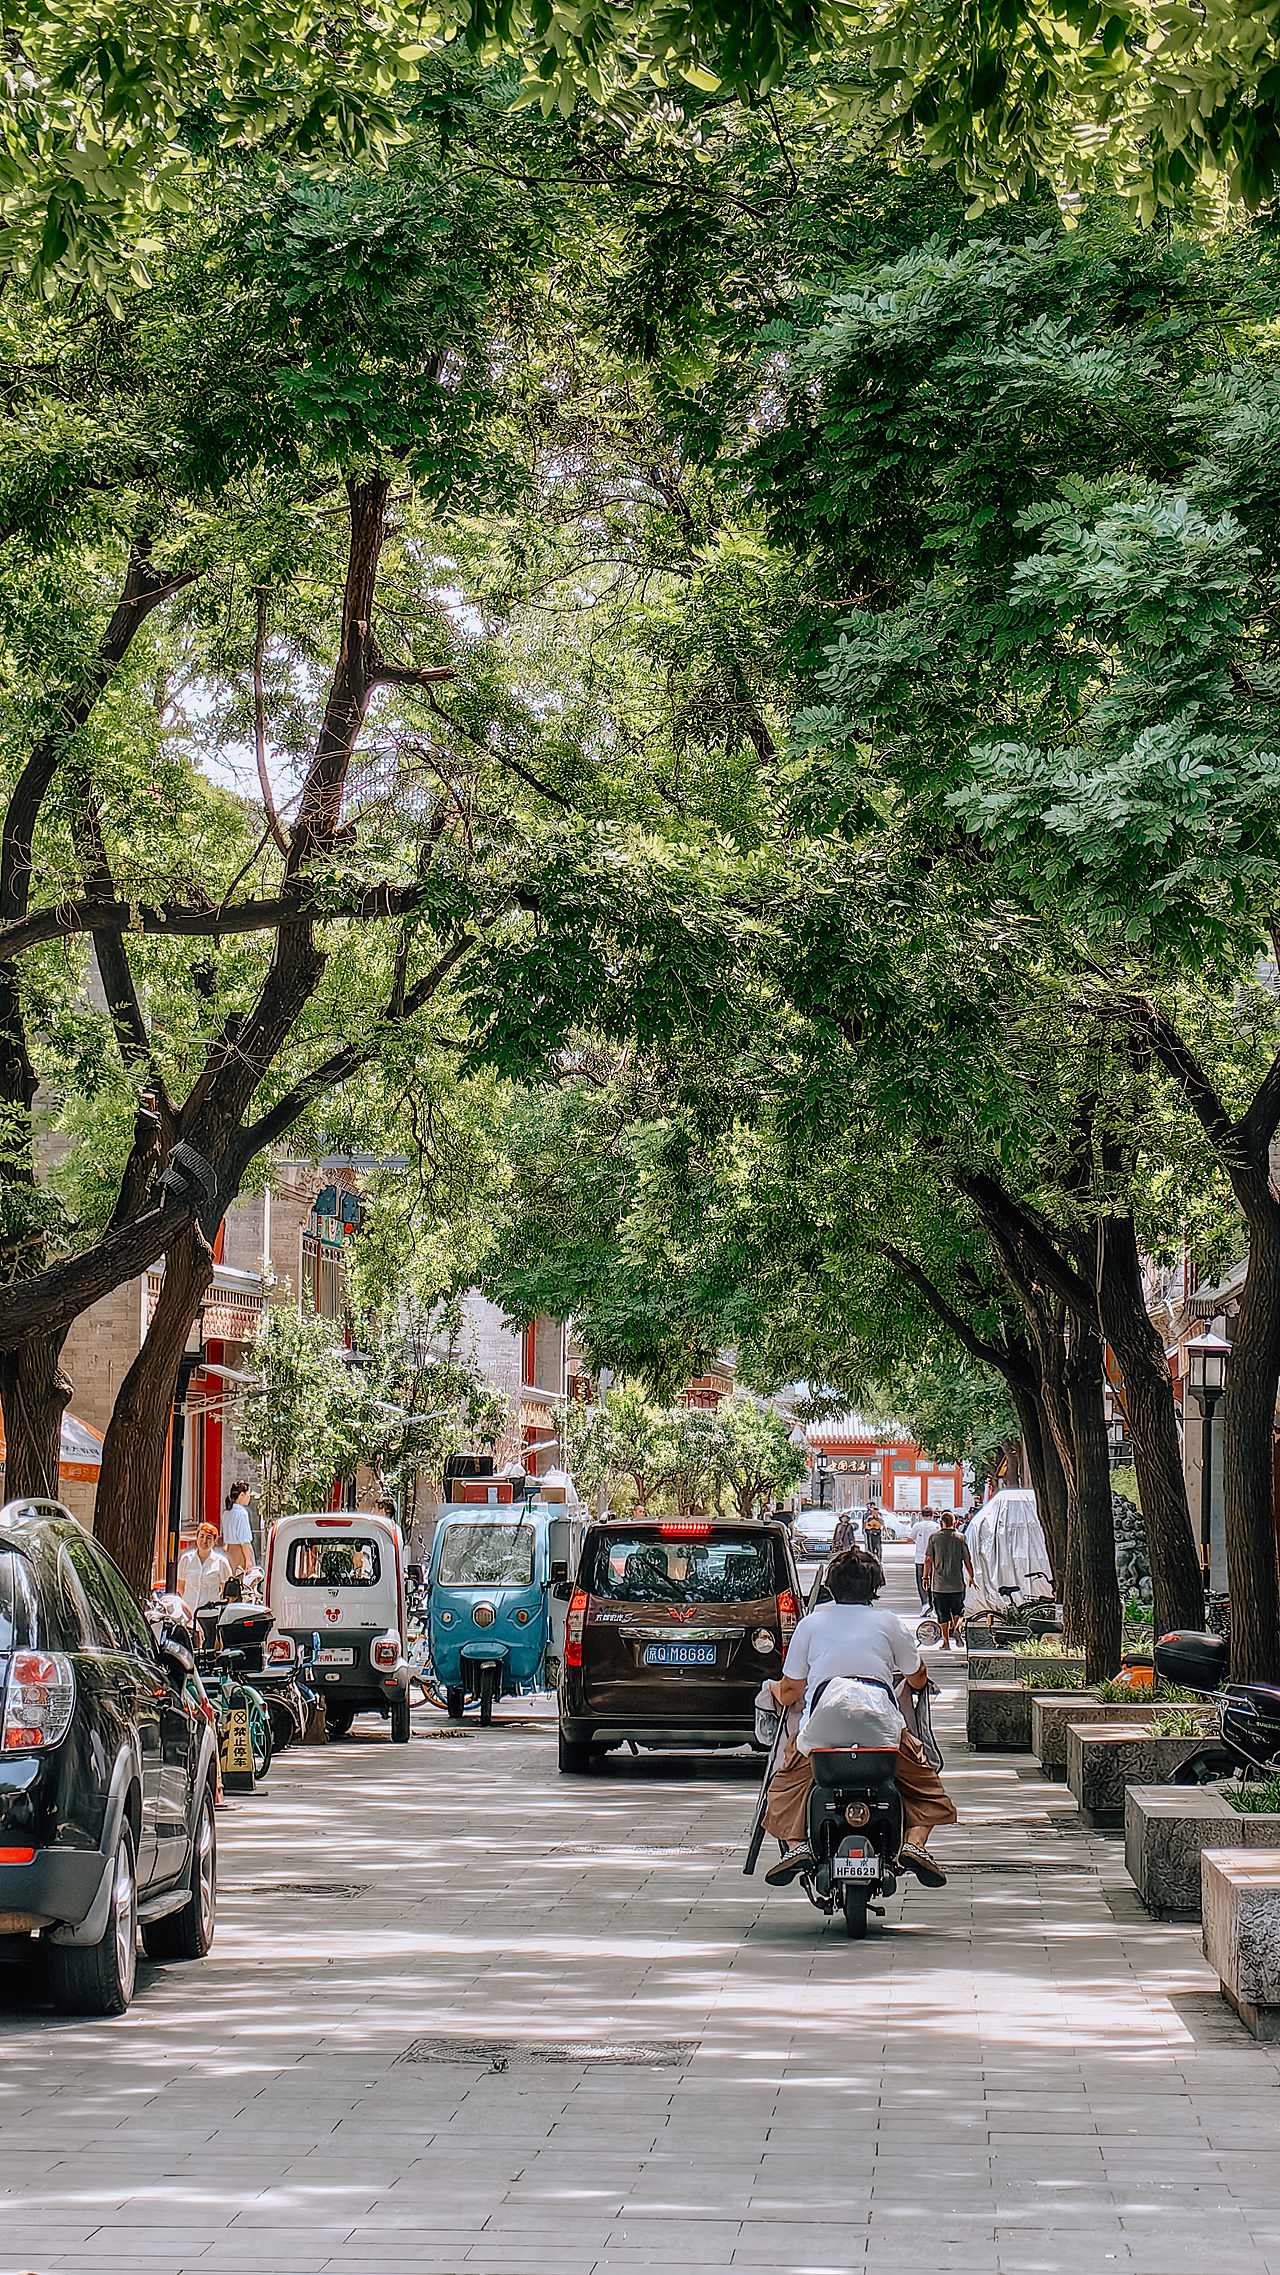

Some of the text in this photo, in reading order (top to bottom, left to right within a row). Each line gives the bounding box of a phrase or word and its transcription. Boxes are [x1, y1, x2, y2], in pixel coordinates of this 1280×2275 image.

[233, 1727, 247, 1767] 禁止停车
[837, 1867, 876, 1876] HF6629
